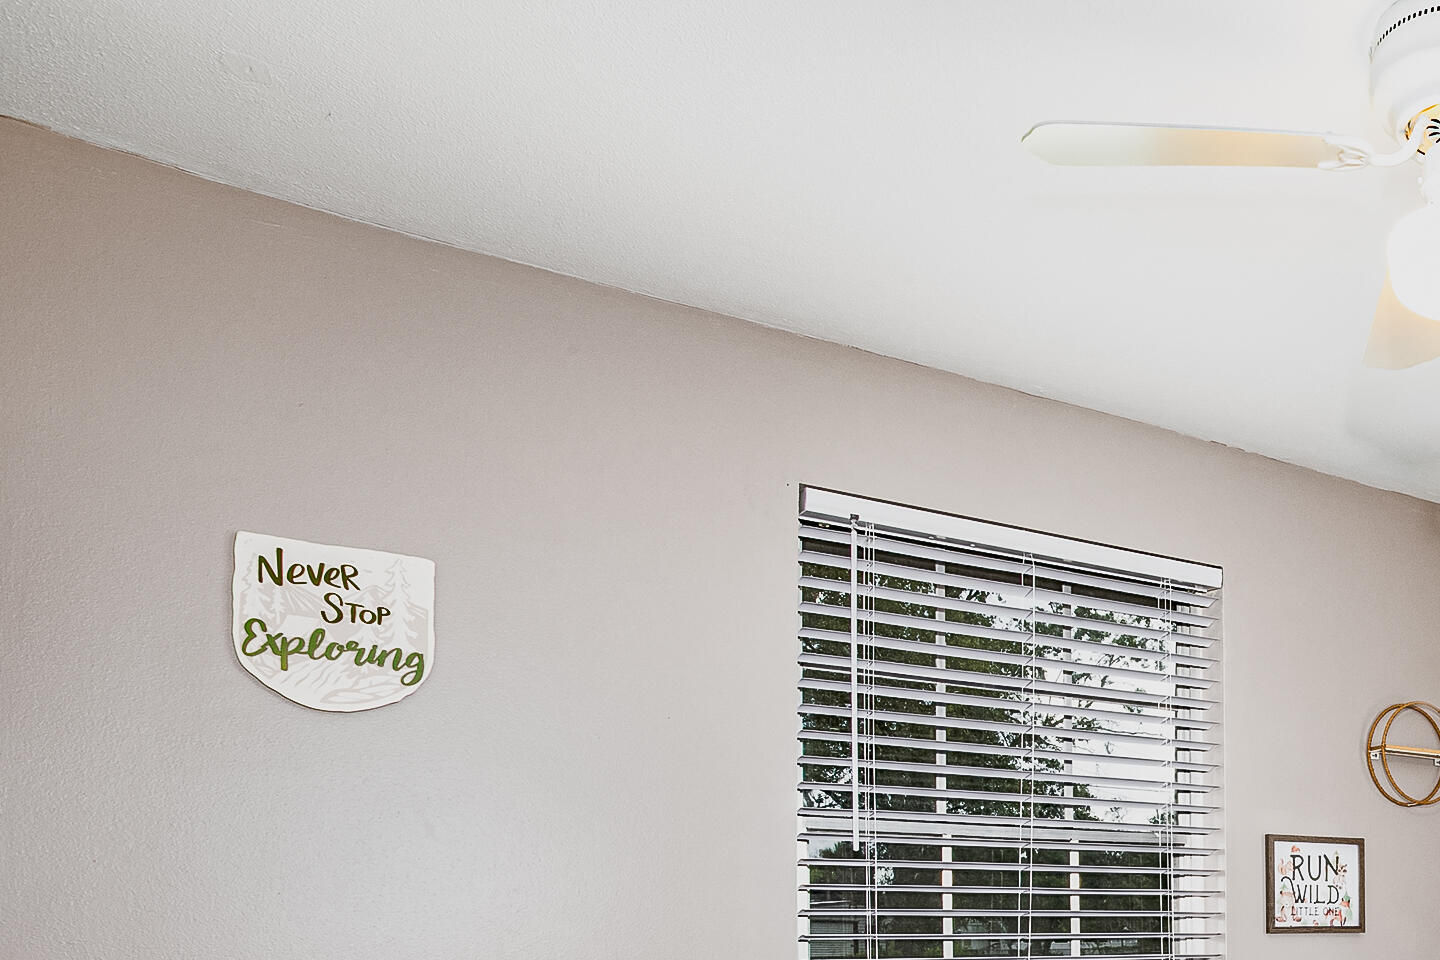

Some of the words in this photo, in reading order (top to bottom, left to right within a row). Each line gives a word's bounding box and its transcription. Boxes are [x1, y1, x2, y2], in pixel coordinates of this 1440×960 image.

[242, 618, 425, 686] Exploring
[1290, 854, 1340, 882] RUN
[1281, 876, 1340, 905] WILD
